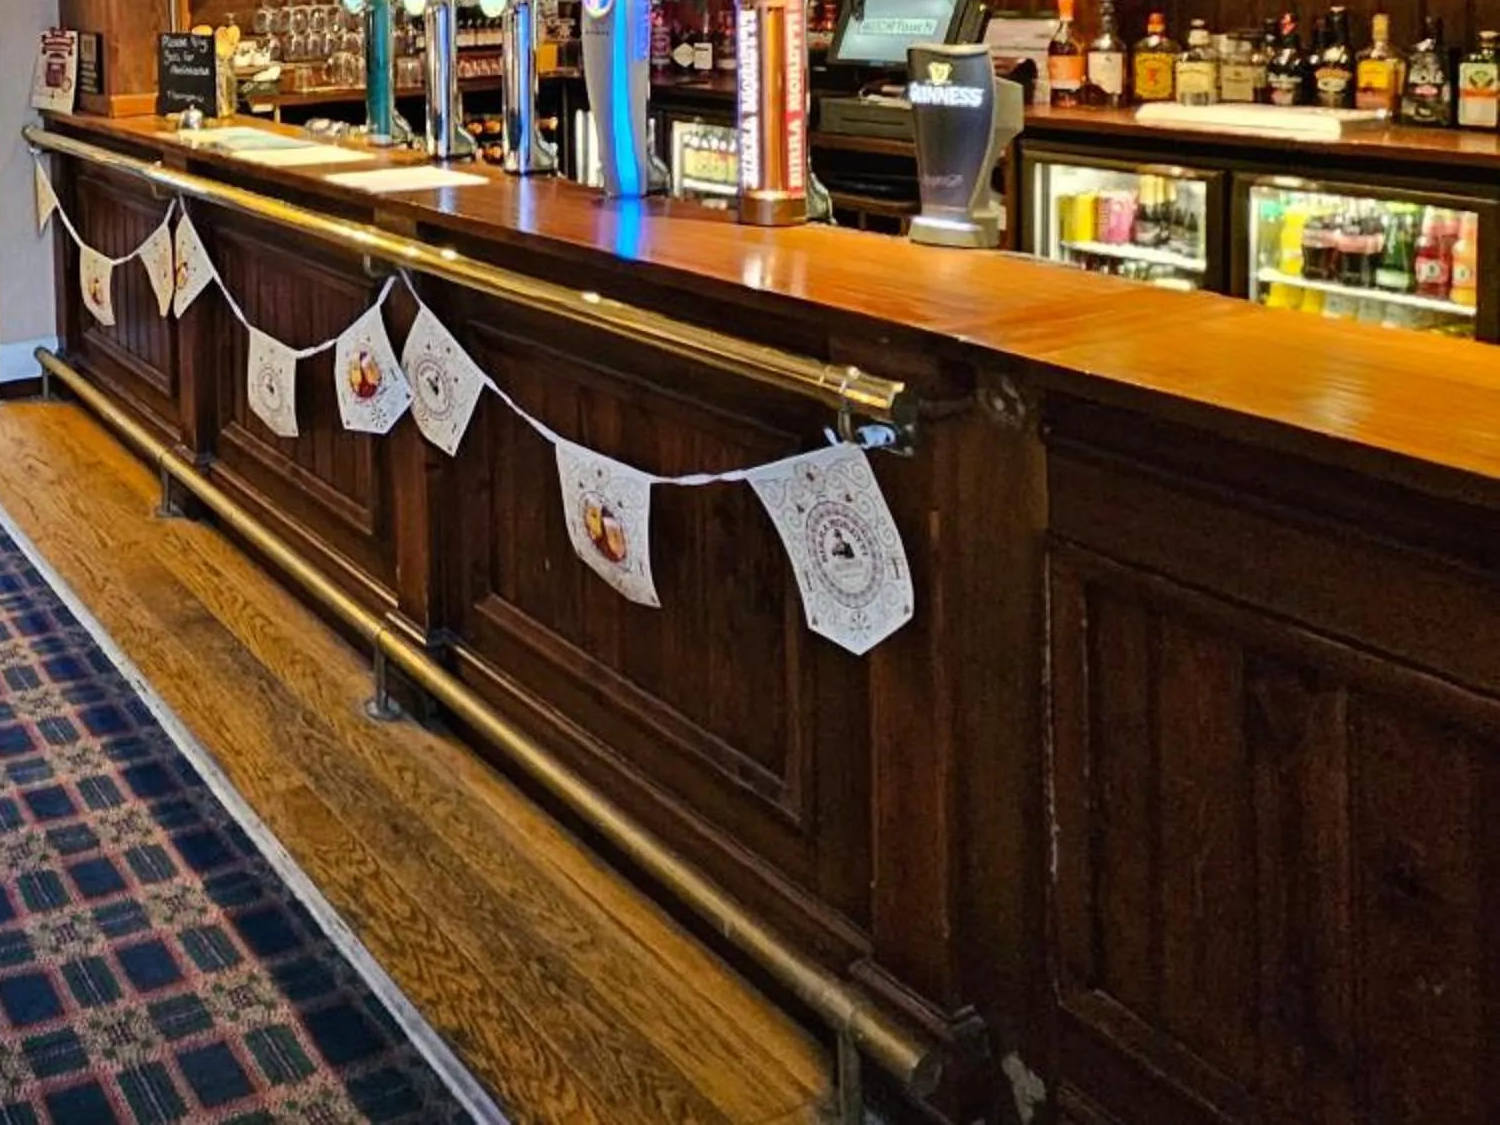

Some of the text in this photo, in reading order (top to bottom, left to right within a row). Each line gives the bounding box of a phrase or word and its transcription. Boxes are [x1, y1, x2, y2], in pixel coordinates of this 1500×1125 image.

[785, 15, 803, 111] MORETTI
[909, 81, 984, 108] GUINNESS
[787, 118, 803, 187] BIRRA
